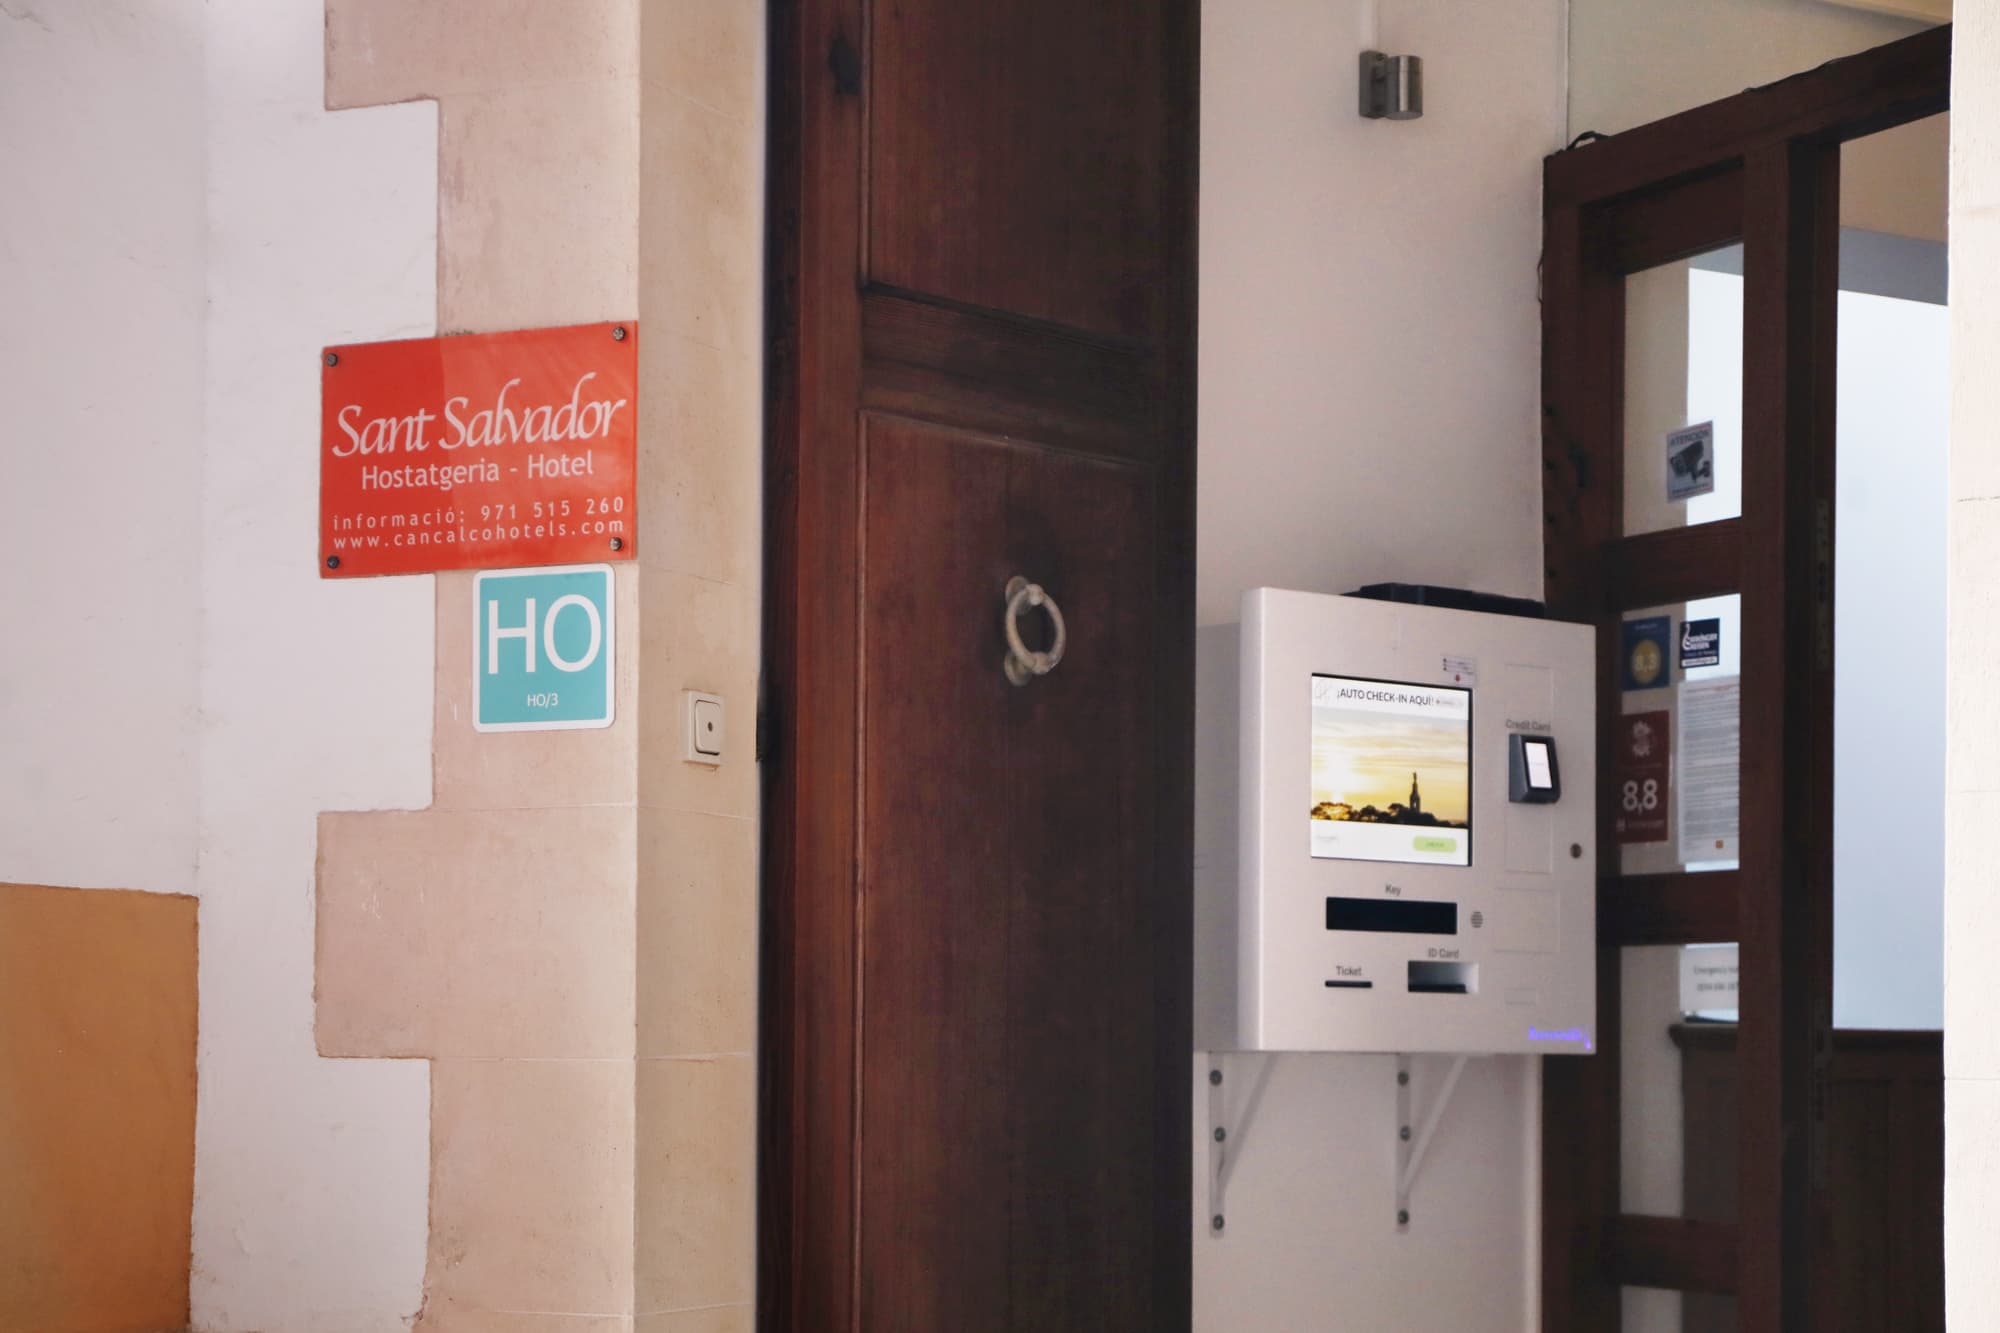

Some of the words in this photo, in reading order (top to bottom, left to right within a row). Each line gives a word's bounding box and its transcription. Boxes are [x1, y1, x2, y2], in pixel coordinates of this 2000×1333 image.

[332, 405, 436, 457] Sant
[438, 371, 627, 450] Salvador
[361, 458, 500, 491] Hostatgeria
[527, 450, 593, 479] Hotel
[333, 506, 465, 531] informació:
[481, 504, 516, 521] 971
[534, 500, 570, 518] 515
[586, 496, 624, 514] 260
[333, 519, 624, 549] www.cancalcohotels.com
[488, 594, 601, 674] HO
[527, 692, 559, 708] HO/3
[1366, 690, 1408, 703] CHECK-IN
[1623, 778, 1658, 815] 8,8
[1385, 884, 1401, 896] Key
[1428, 947, 1438, 958] ID
[1439, 948, 1459, 960] Card
[1336, 965, 1362, 977] Ticket
